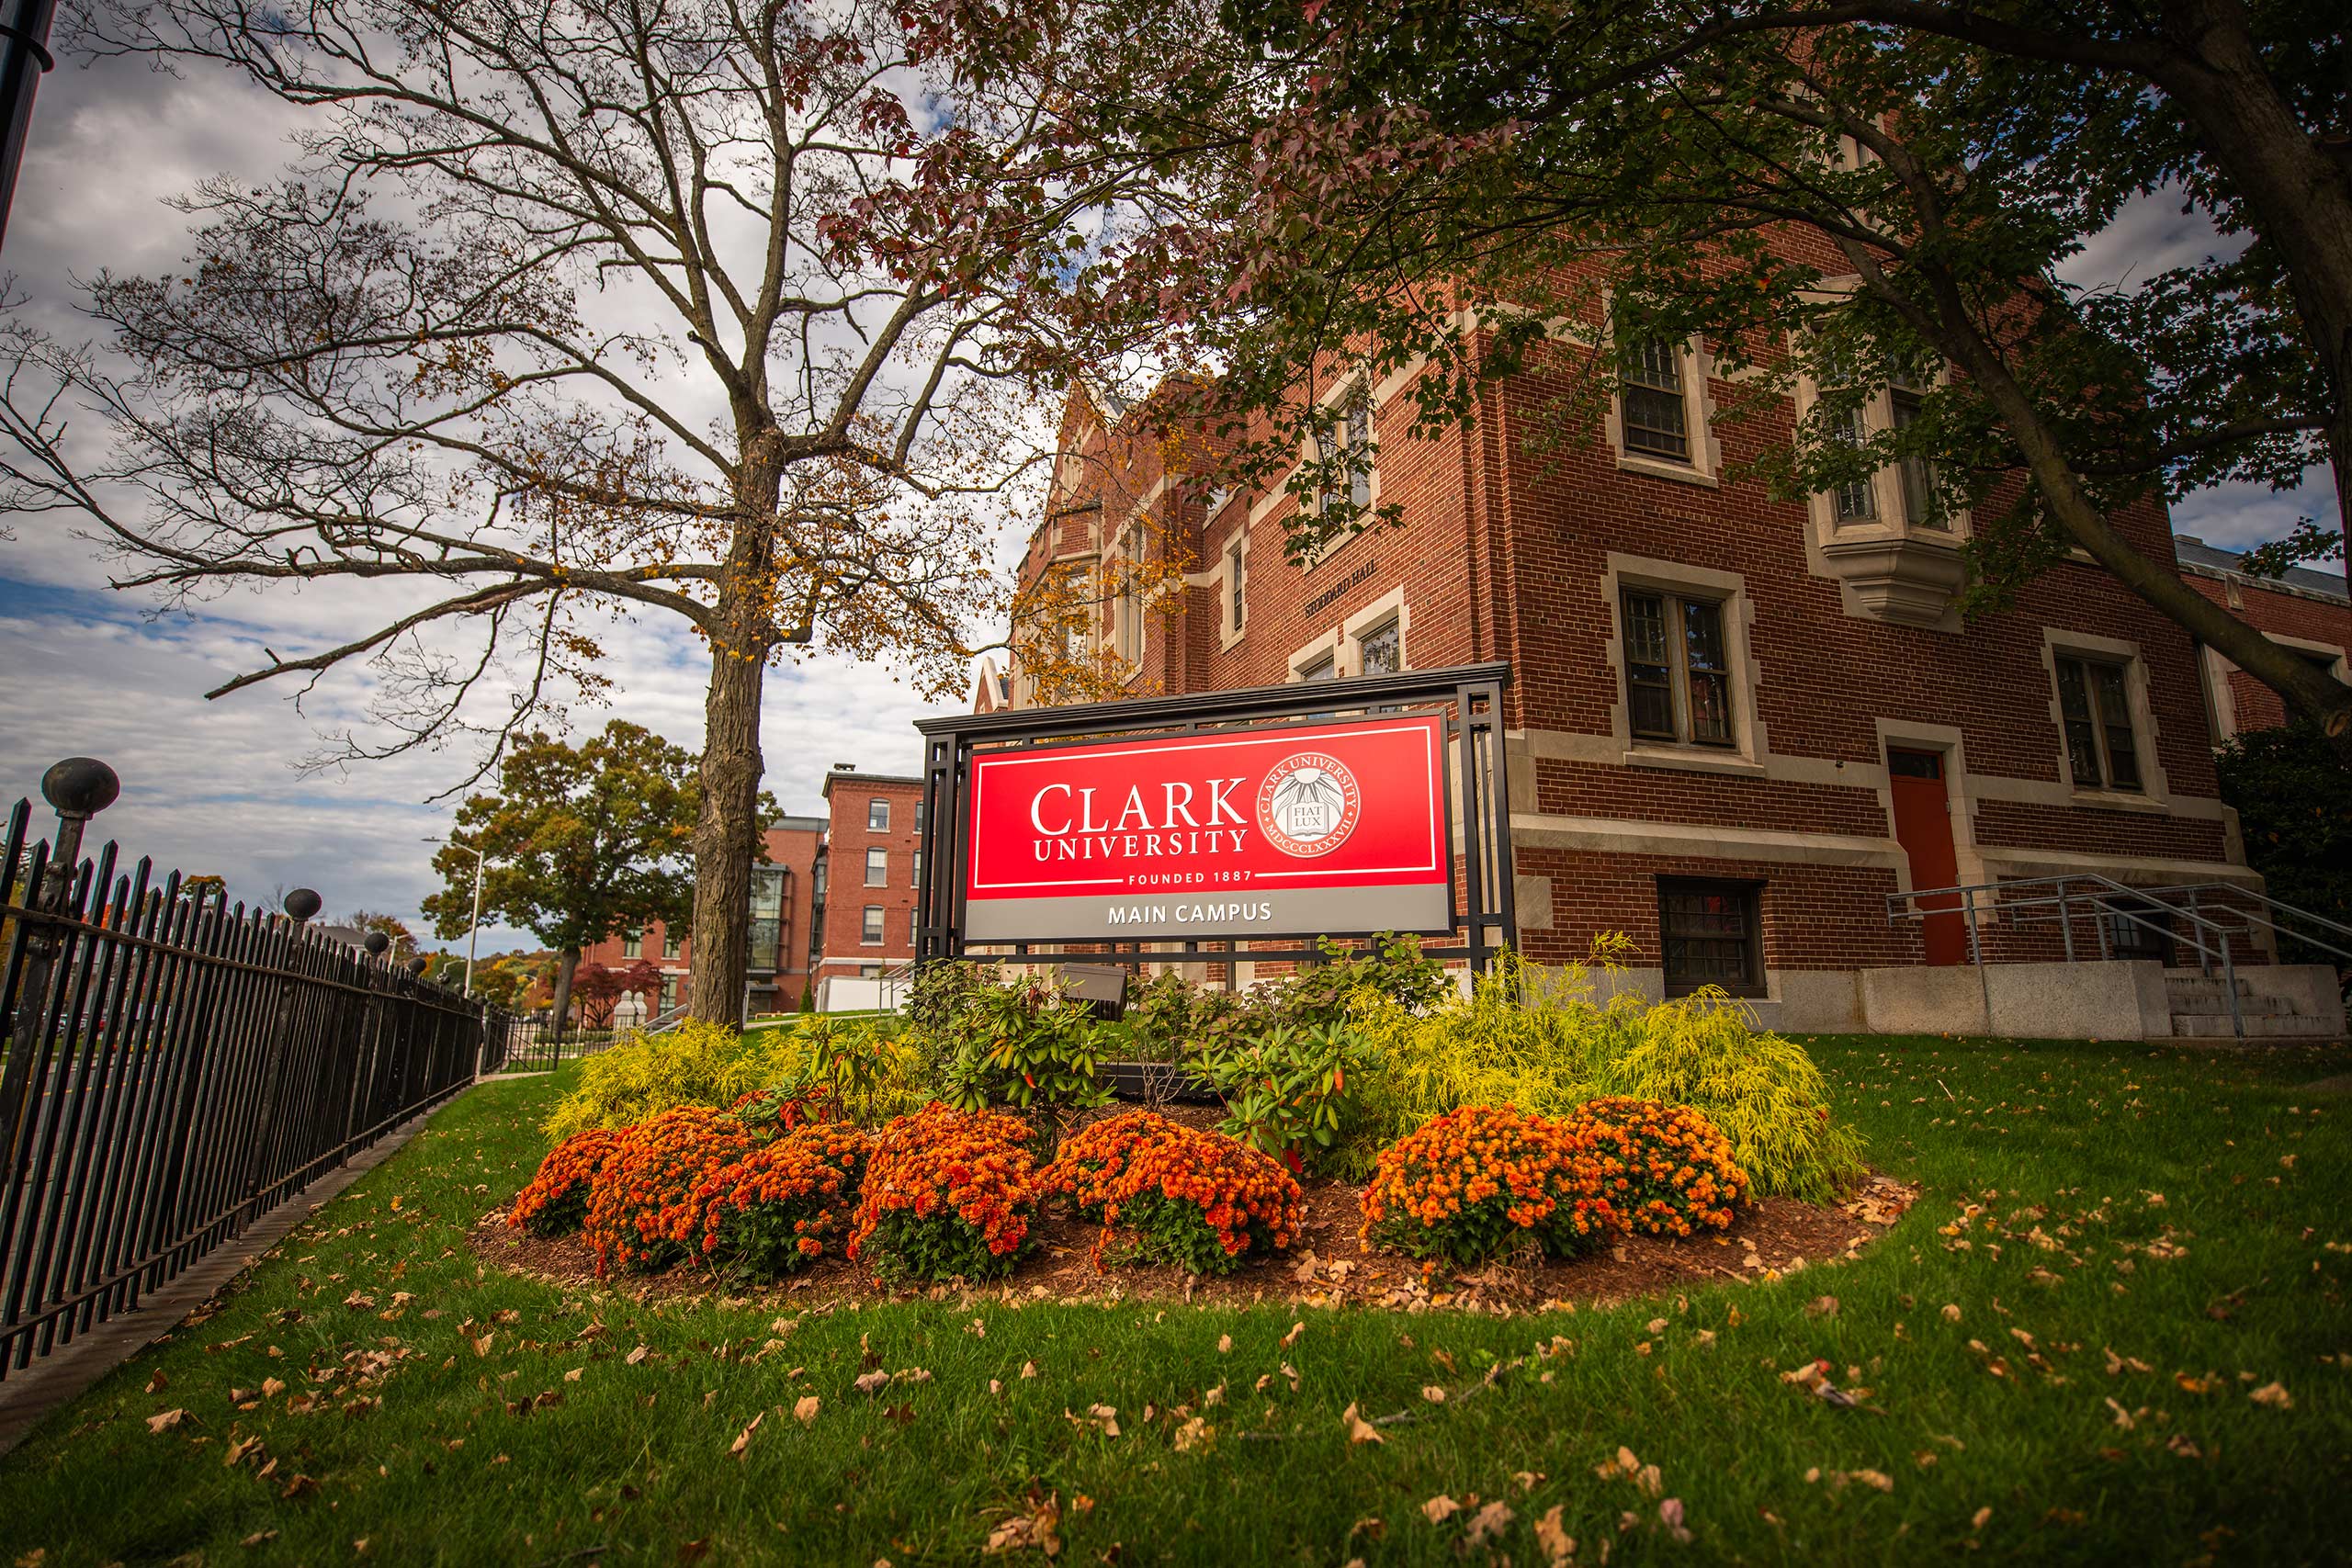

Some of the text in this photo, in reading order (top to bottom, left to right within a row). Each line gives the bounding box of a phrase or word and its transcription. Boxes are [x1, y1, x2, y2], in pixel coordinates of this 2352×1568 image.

[1305, 558, 1378, 619] STODDARD HALL
[1261, 756, 1357, 813] CLARK UNIVERSITY
[1030, 777, 1249, 836] CLARK
[1295, 806, 1322, 817] FIAT
[1295, 817, 1321, 827] LUX
[1034, 829, 1249, 862] UNIVERSITY
[1266, 819, 1351, 853] MDCCCLXXXVII
[1128, 871, 1251, 886] FOUNDED 1887
[1108, 903, 1272, 925] MAIN CAMPUS
